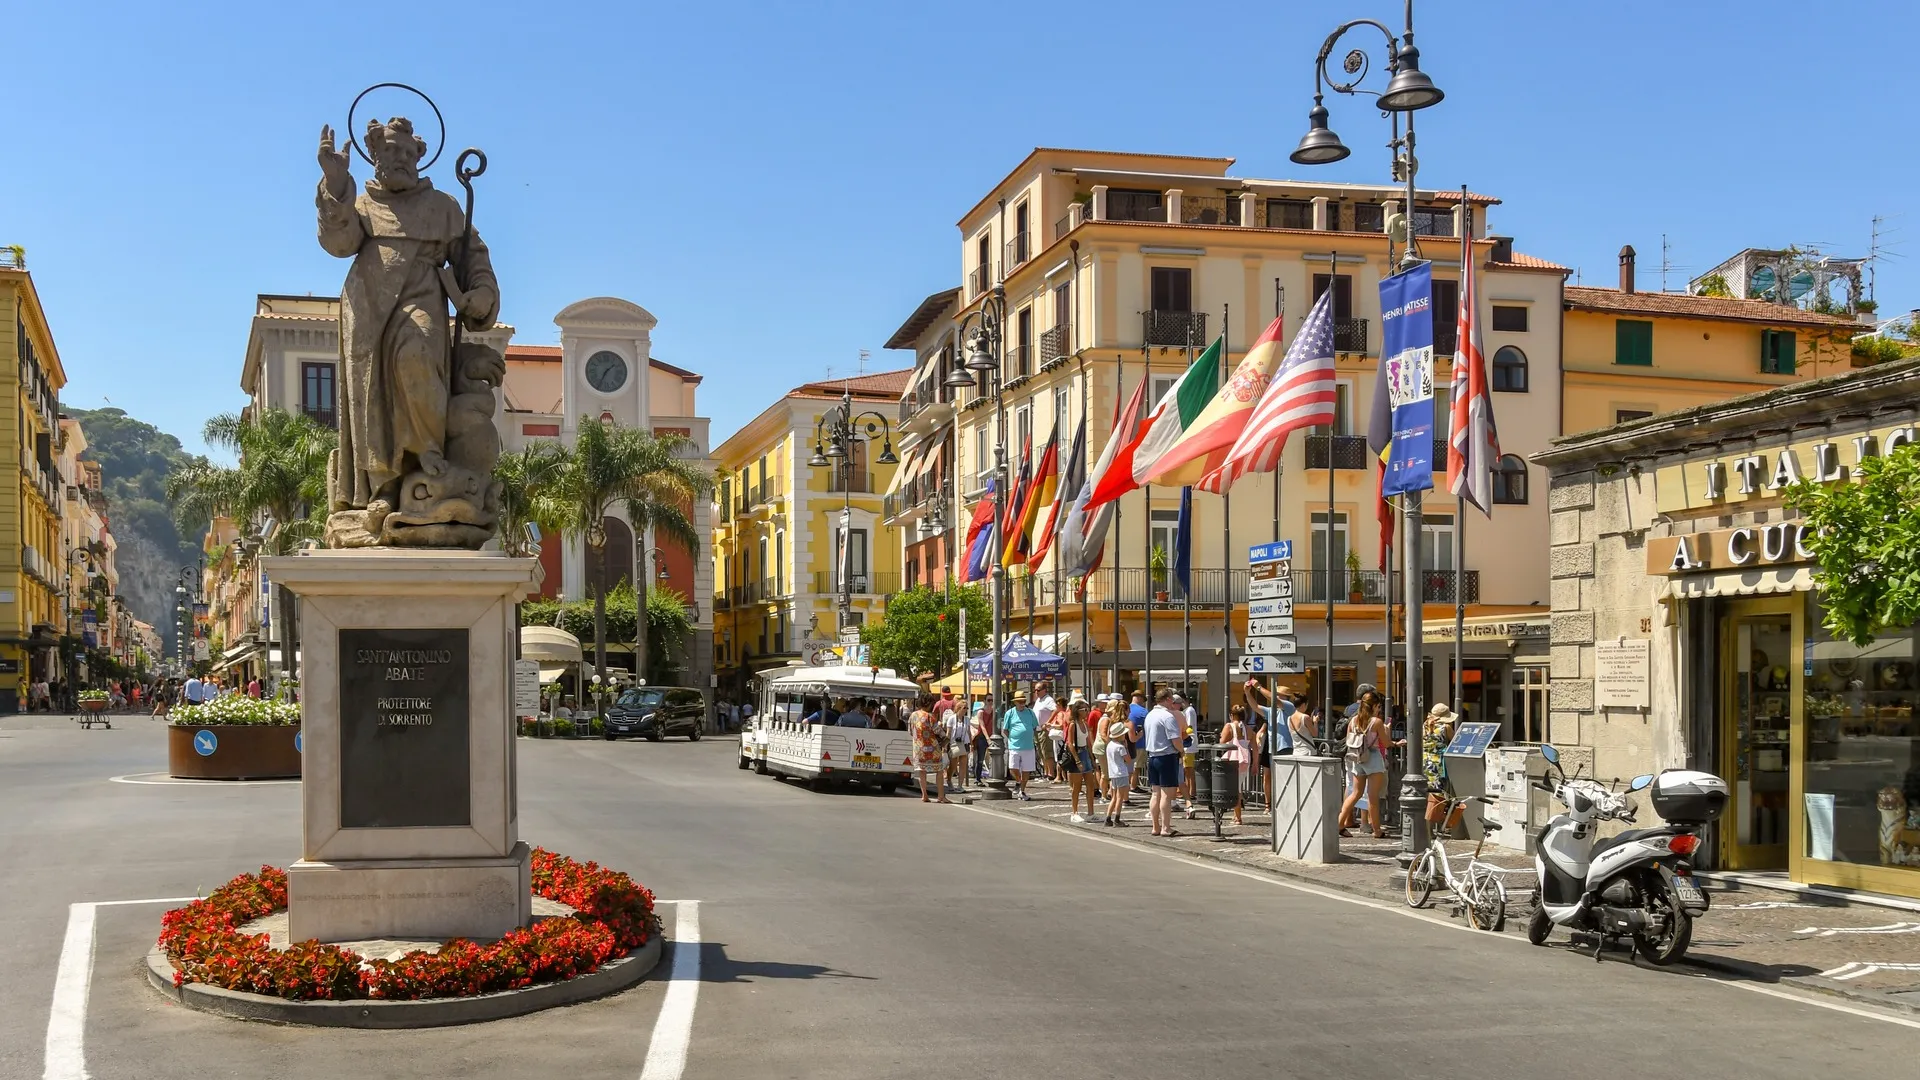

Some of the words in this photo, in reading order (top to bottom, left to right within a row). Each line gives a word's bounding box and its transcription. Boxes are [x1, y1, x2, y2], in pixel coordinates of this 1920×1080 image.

[1382, 307, 1402, 321] HENRI
[1250, 547, 1268, 559] NAPOLI
[1250, 605, 1273, 614] BANCOMAT
[385, 668, 425, 681] ABATE
[377, 698, 432, 710] PROTETTORE
[378, 715, 386, 725] DI
[388, 714, 432, 725] SORRENTO
